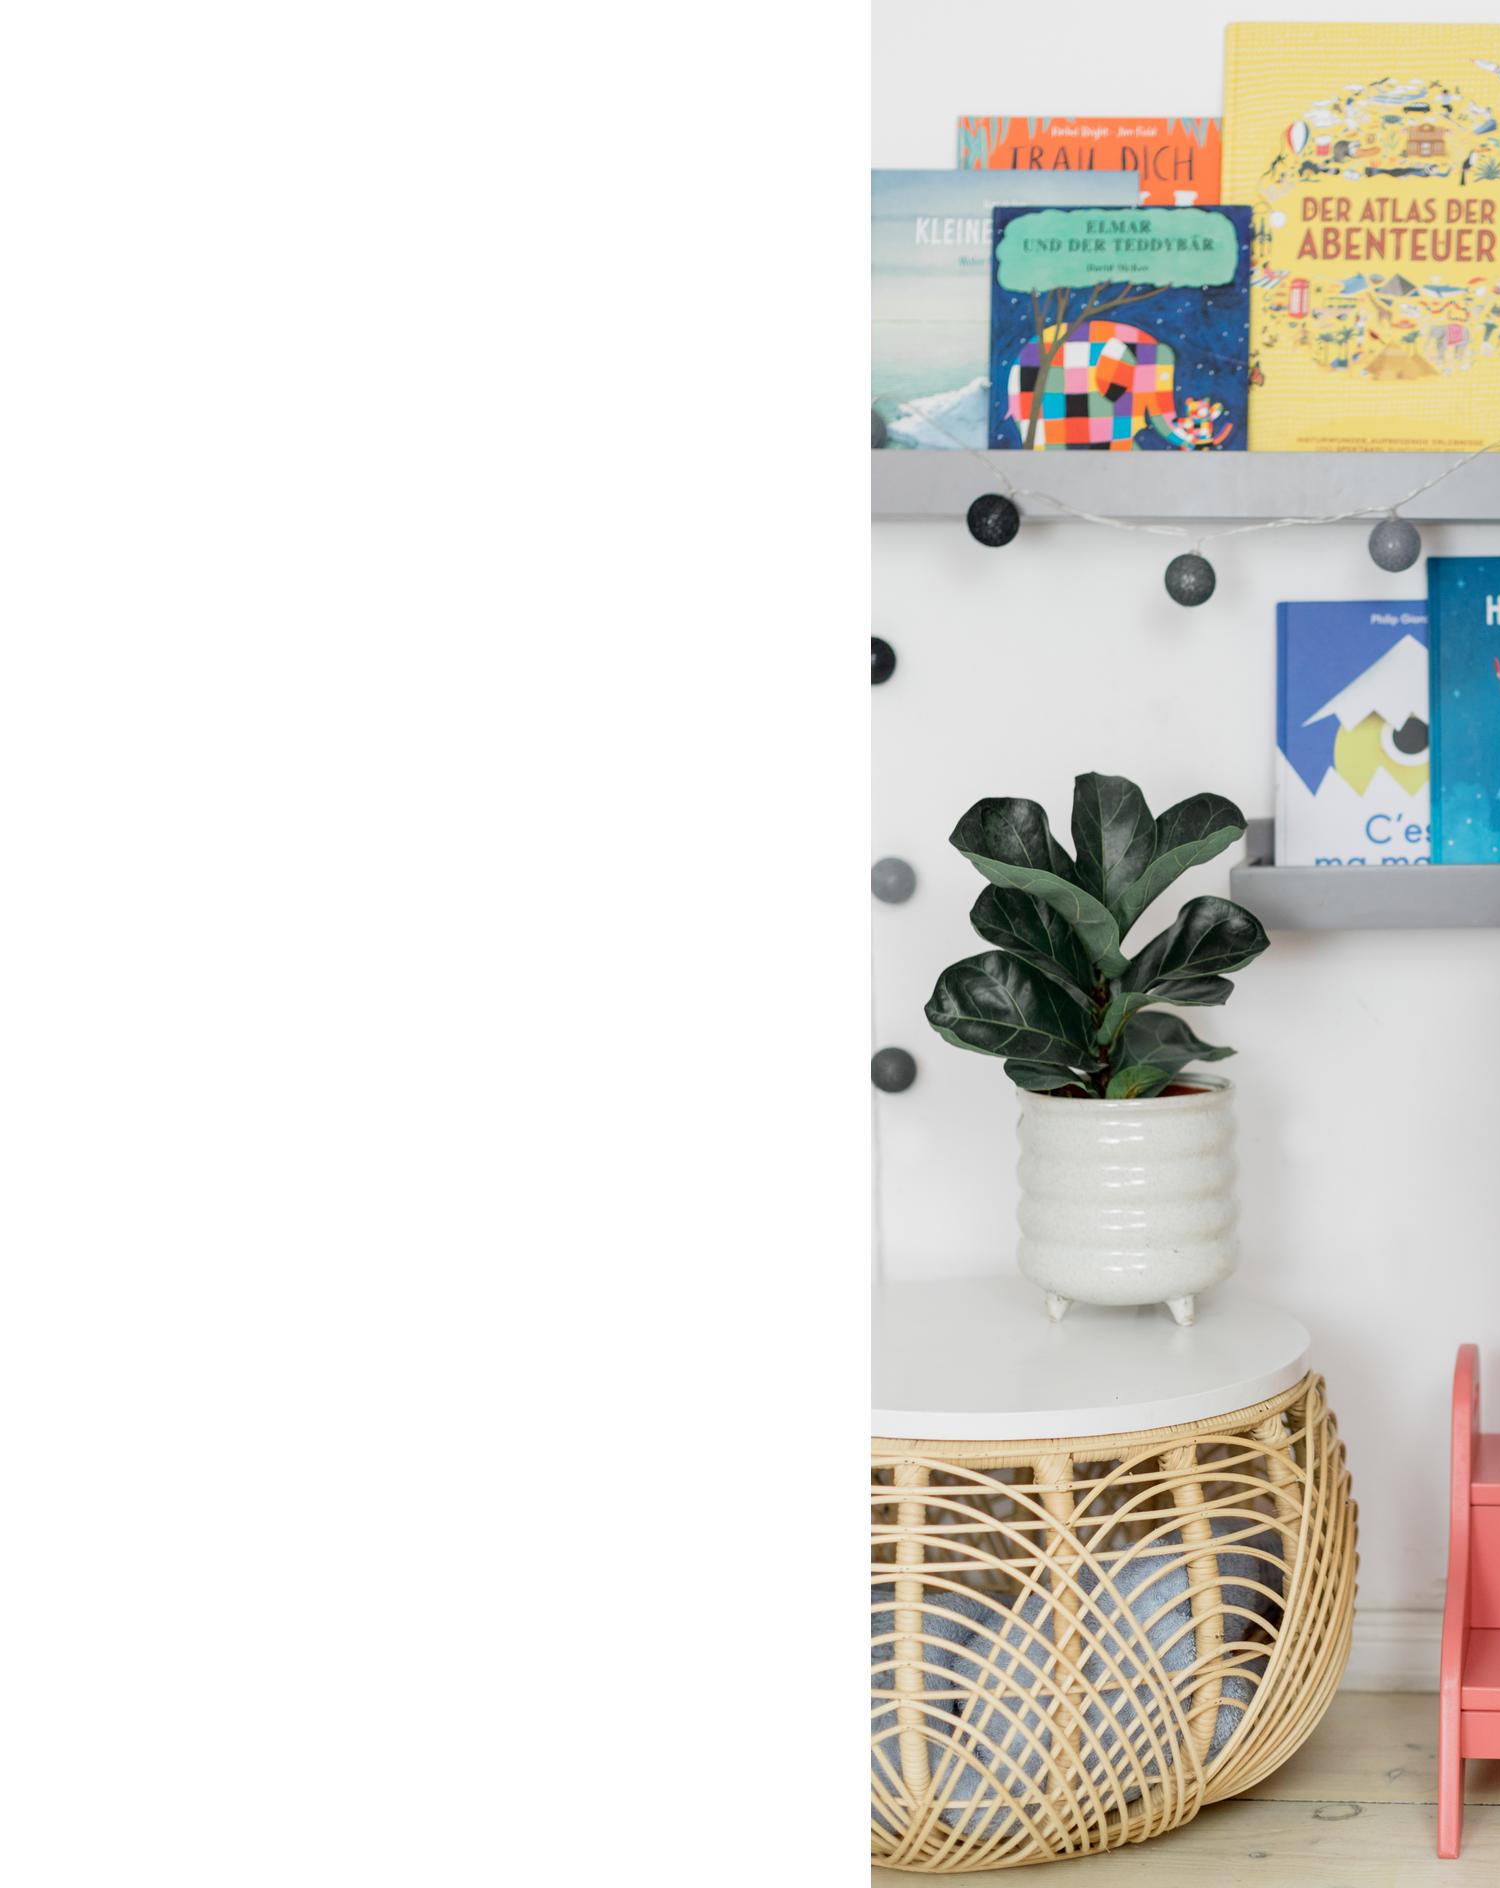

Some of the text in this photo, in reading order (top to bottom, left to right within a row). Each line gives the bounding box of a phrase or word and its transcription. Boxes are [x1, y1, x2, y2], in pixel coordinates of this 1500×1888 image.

[1121, 145, 1196, 182] DICH
[1301, 197, 1496, 224] DER ATLAS DER
[1086, 220, 1152, 234] ELMAR
[1023, 236, 1215, 252] UND DER TEDDYBÄR
[1297, 227, 1497, 262] ABENTEUER
